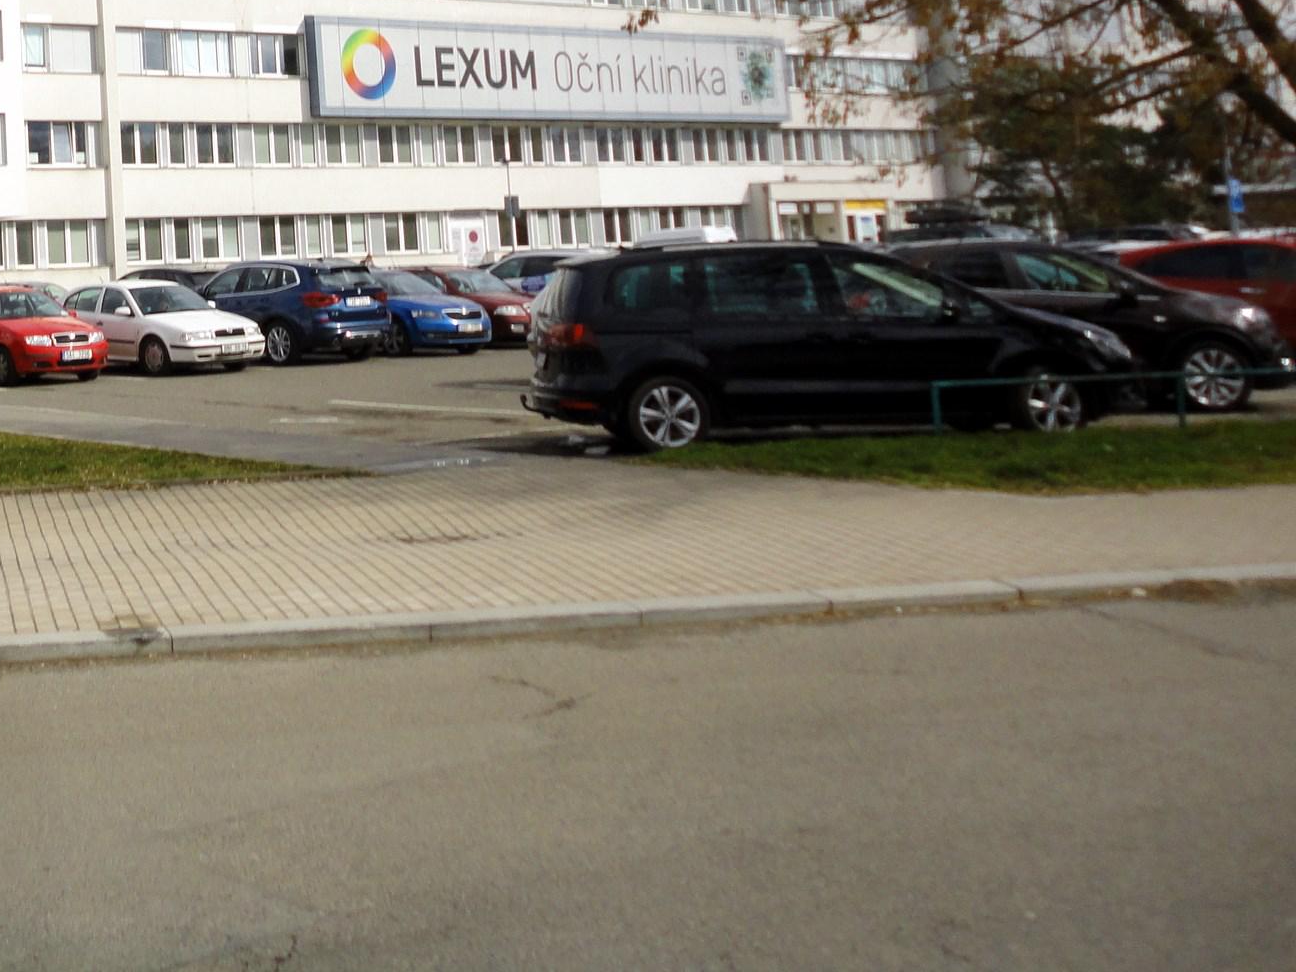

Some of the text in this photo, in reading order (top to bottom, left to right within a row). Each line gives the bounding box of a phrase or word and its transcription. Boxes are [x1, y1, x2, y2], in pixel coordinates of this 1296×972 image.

[414, 45, 726, 96] LEXUM Oční klinika
